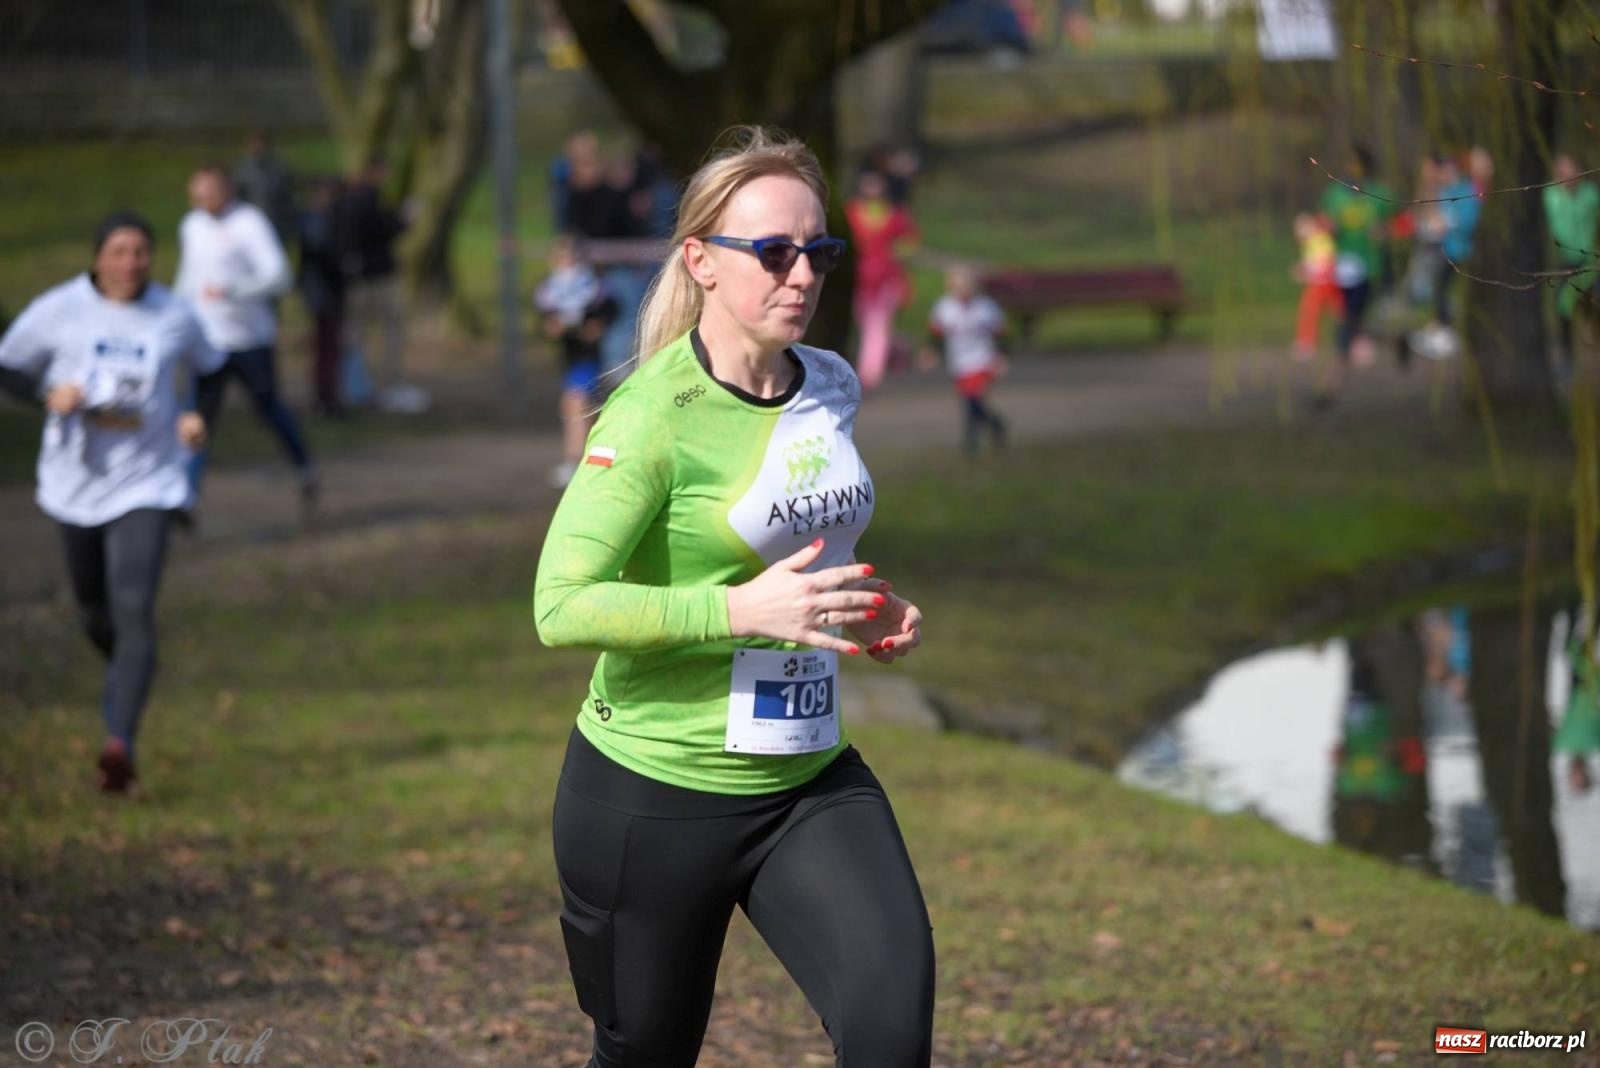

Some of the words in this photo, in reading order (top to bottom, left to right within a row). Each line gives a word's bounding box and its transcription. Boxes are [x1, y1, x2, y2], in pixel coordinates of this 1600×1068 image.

[673, 384, 706, 408] deep
[793, 509, 857, 535] LYSKI
[780, 680, 828, 717] 109
